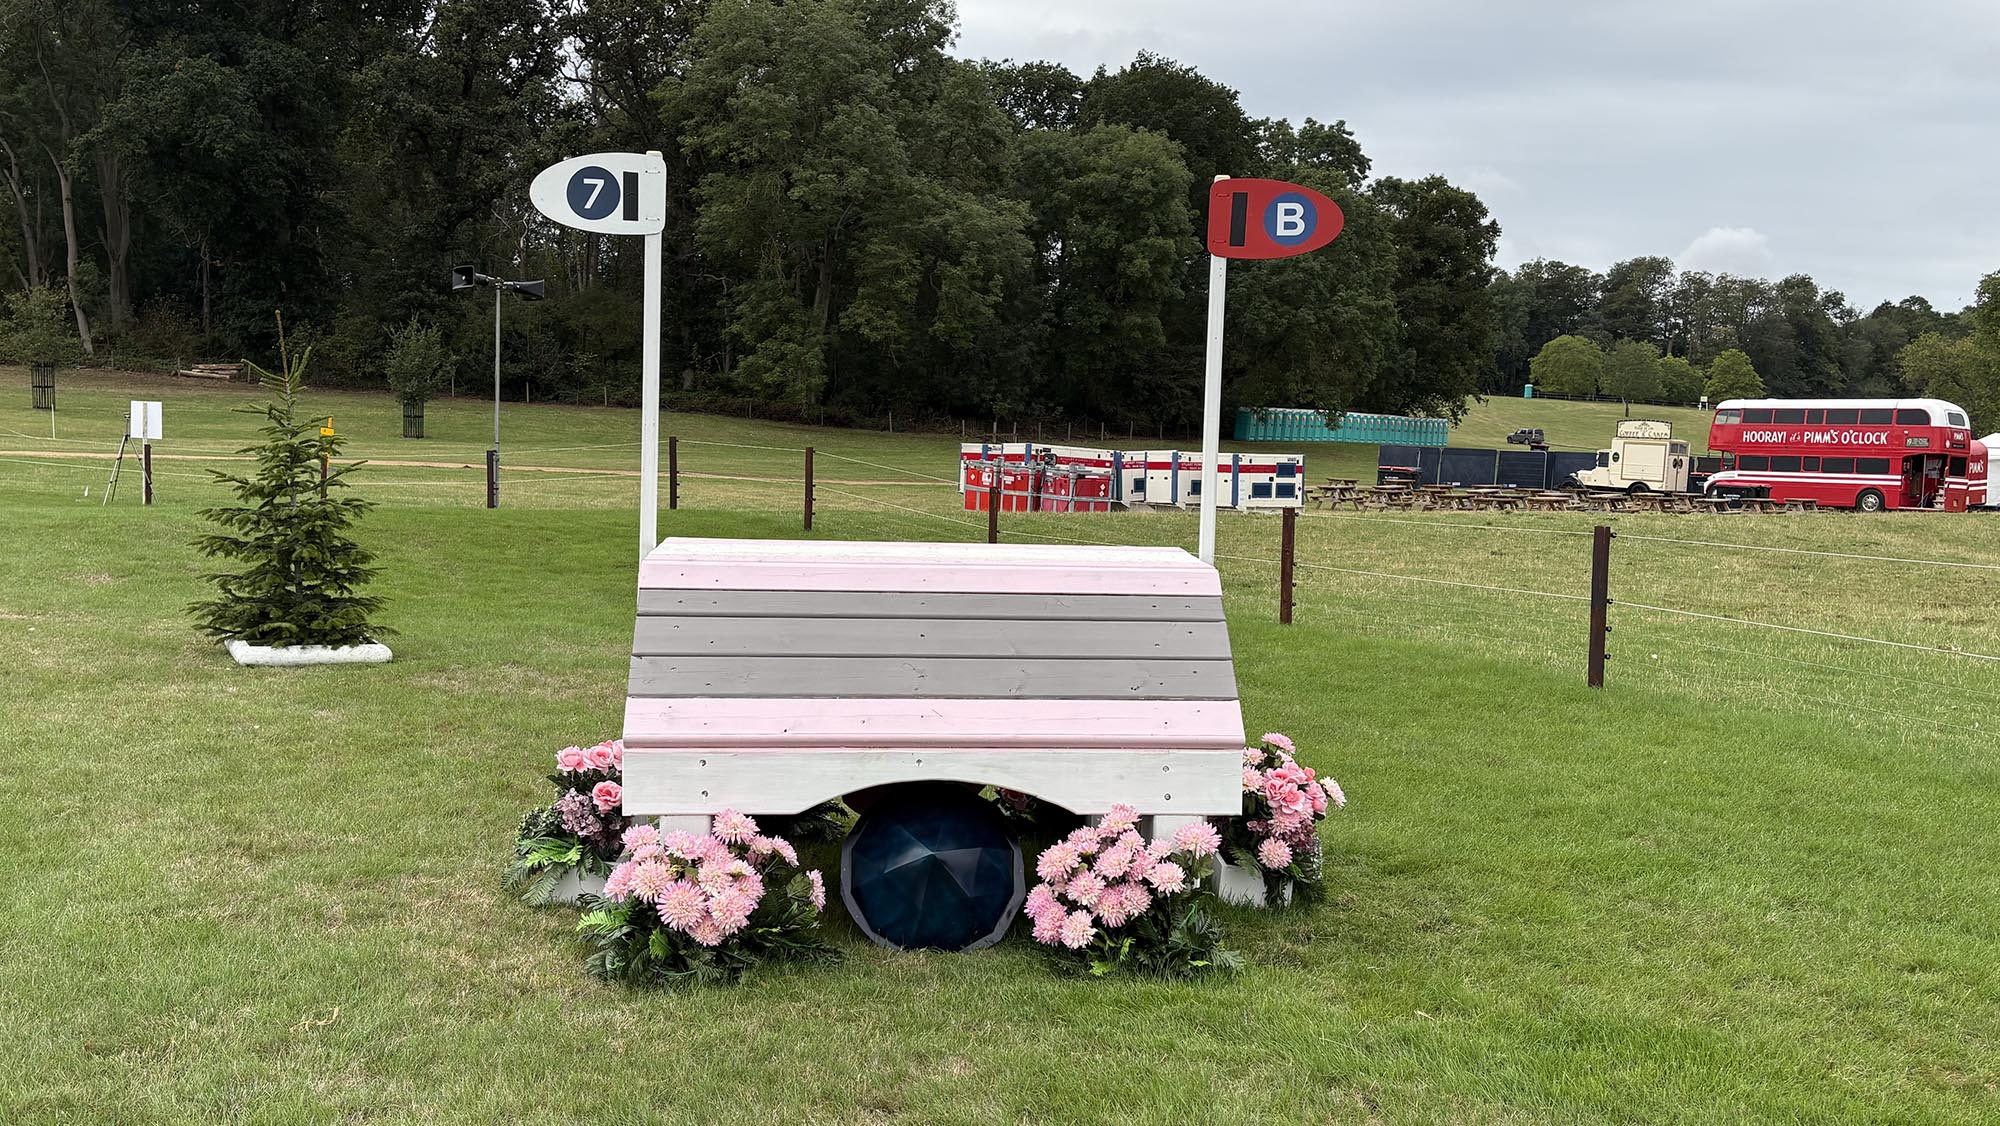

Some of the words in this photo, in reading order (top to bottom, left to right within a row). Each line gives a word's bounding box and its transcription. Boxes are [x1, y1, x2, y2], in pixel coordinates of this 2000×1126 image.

[583, 178, 605, 210] 7
[1276, 202, 1306, 237] B
[1742, 430, 1787, 443] HOORAY!
[1803, 429, 1839, 444] PIMM'S
[1841, 429, 1888, 445] O'CLOCK
